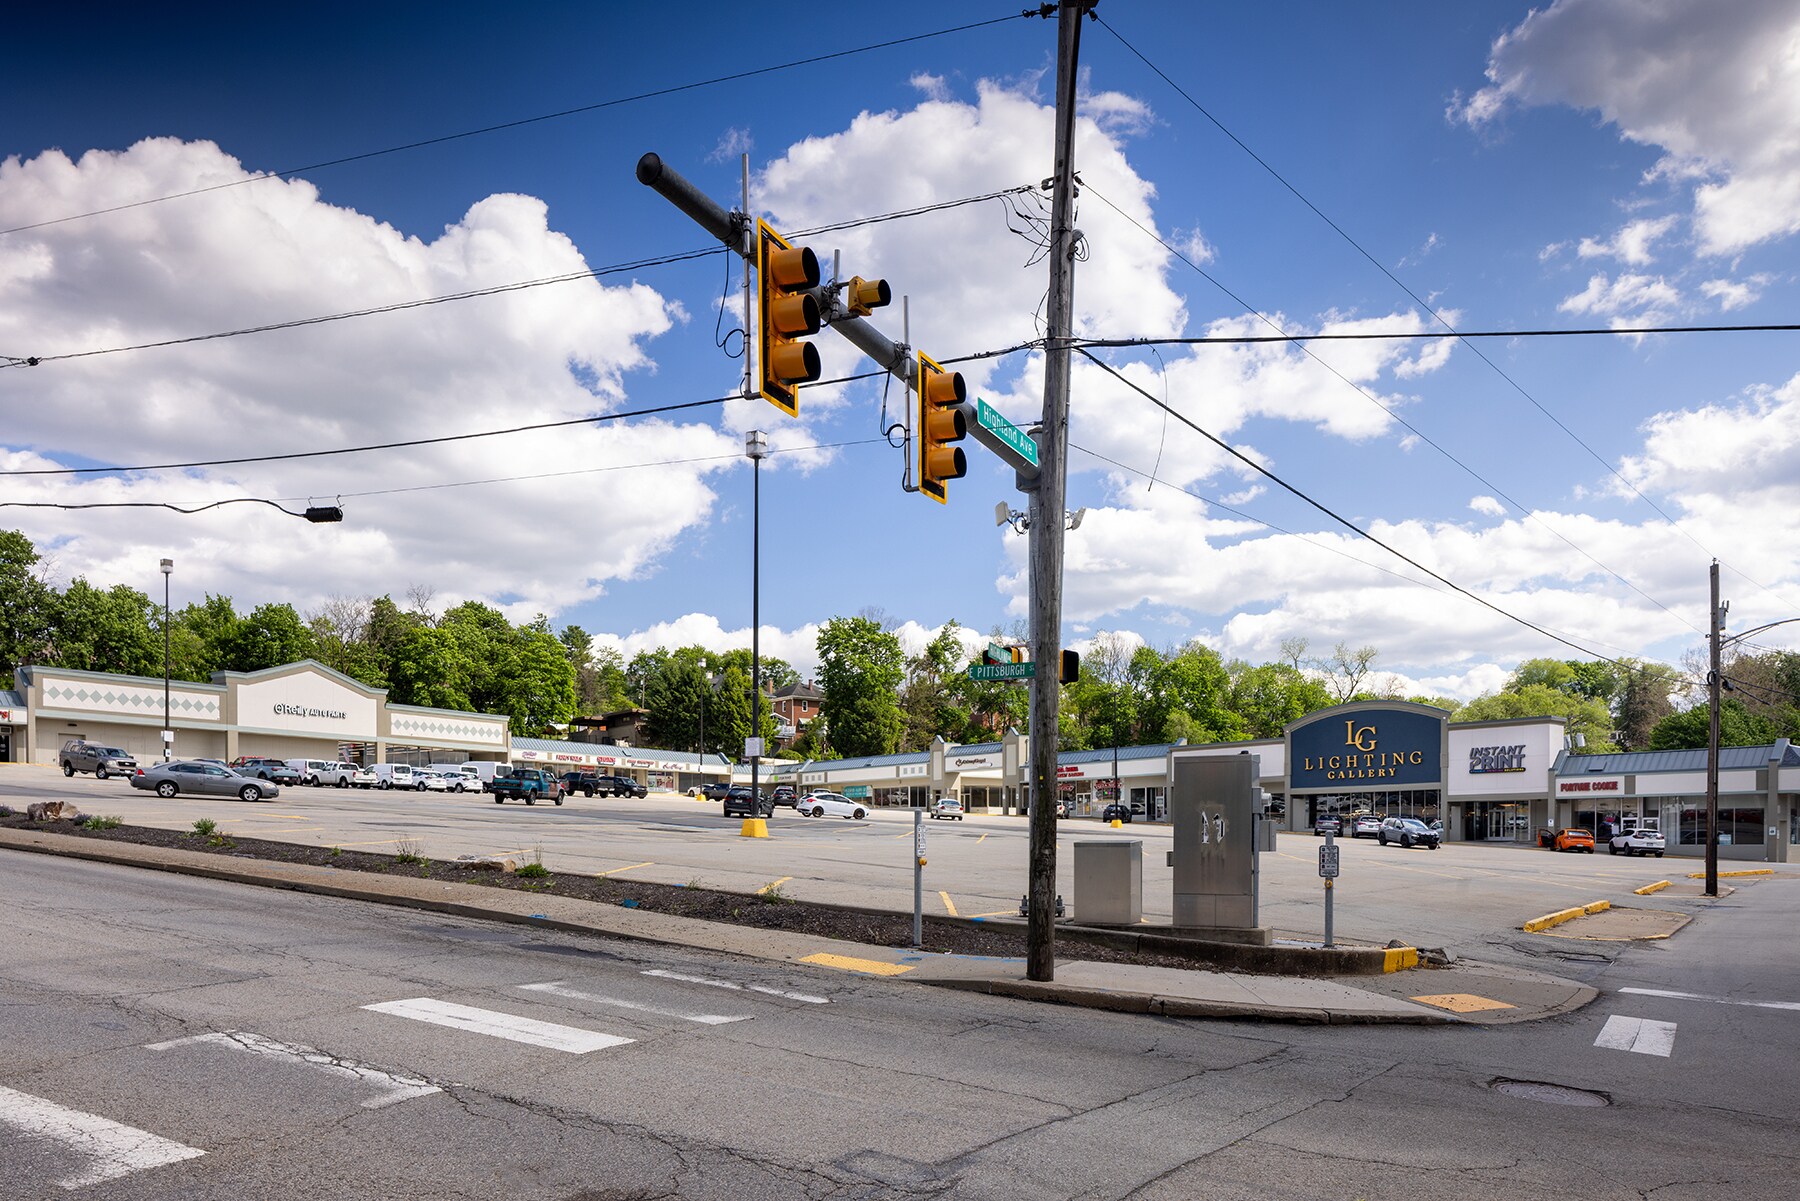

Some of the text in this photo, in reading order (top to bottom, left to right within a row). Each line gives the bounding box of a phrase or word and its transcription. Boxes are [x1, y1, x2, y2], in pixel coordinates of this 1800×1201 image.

[983, 404, 1033, 456] Highland Ave
[969, 667, 974, 679] E
[977, 664, 1026, 678] PITTSBURGH
[273, 703, 347, 719] O'Reilly AUTO PARTS
[1345, 720, 1377, 752] LG
[1469, 744, 1526, 758] INSTANT
[1304, 750, 1423, 770] LIGHTING
[1469, 753, 1526, 770] PRINT
[1327, 767, 1396, 780] GALLERY
[1560, 781, 1619, 792] FORTUNE COOKIE
